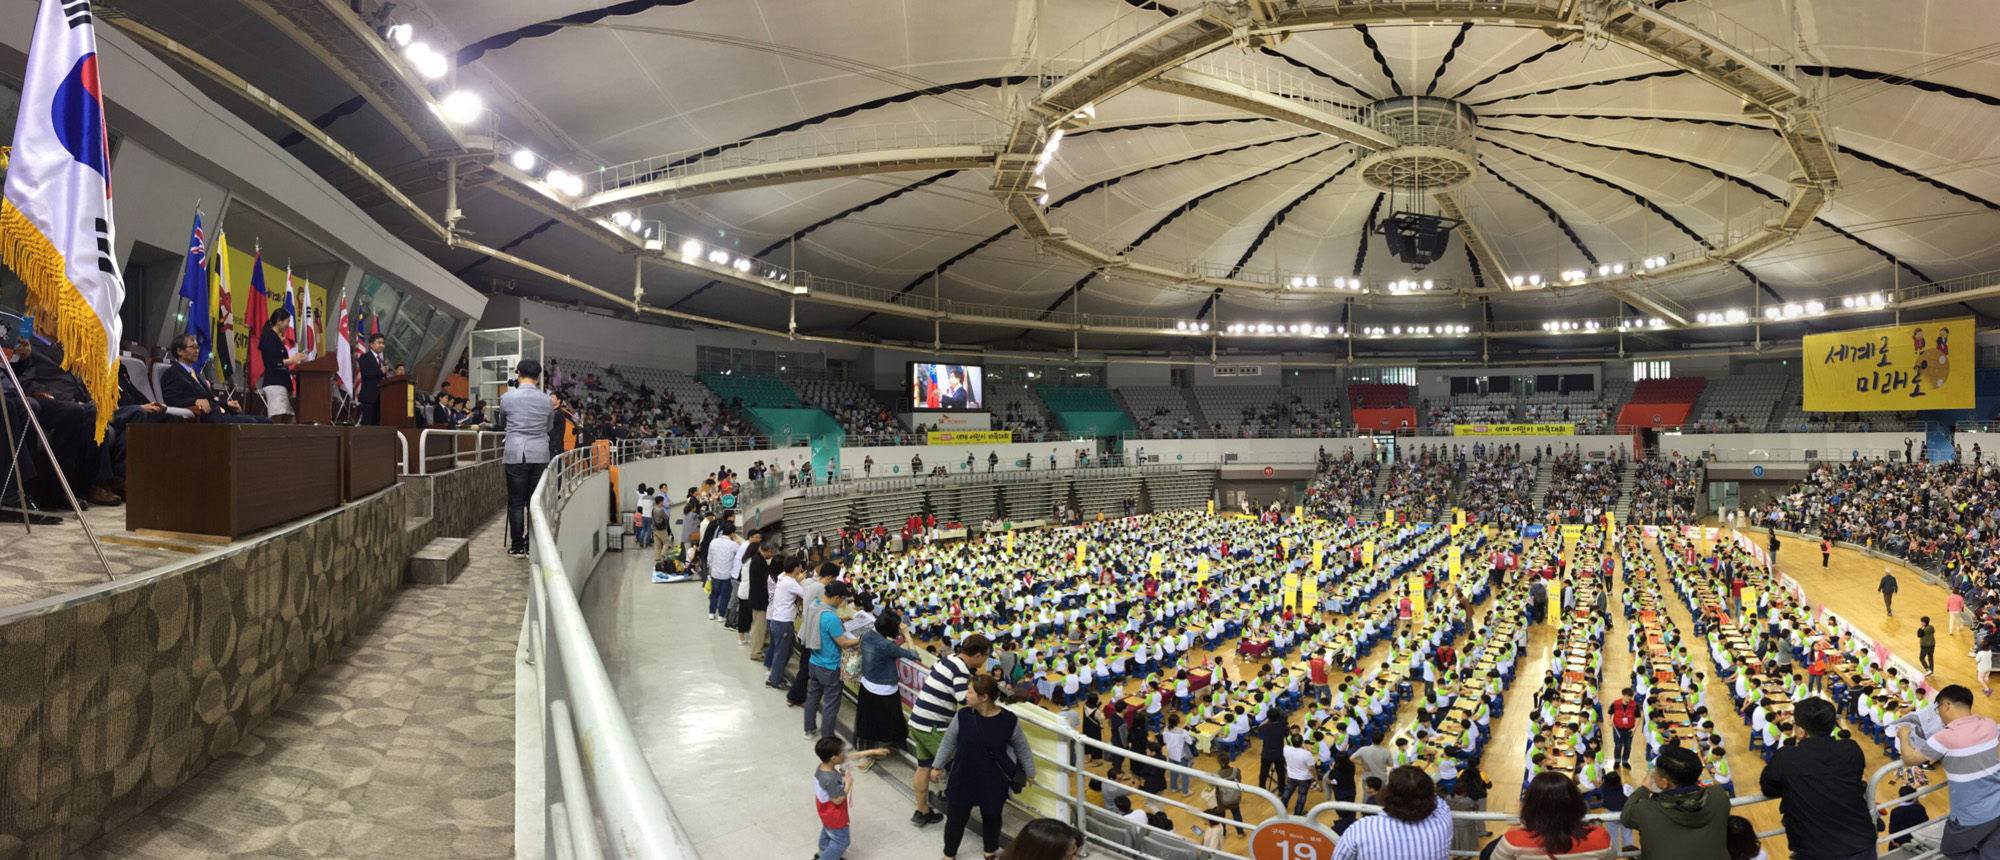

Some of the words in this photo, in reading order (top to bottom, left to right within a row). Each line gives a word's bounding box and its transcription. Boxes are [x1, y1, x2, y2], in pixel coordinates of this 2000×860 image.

[1824, 336, 1892, 367] 세계로
[1856, 365, 1925, 397] 미래로
[1276, 840, 1317, 860] 19
